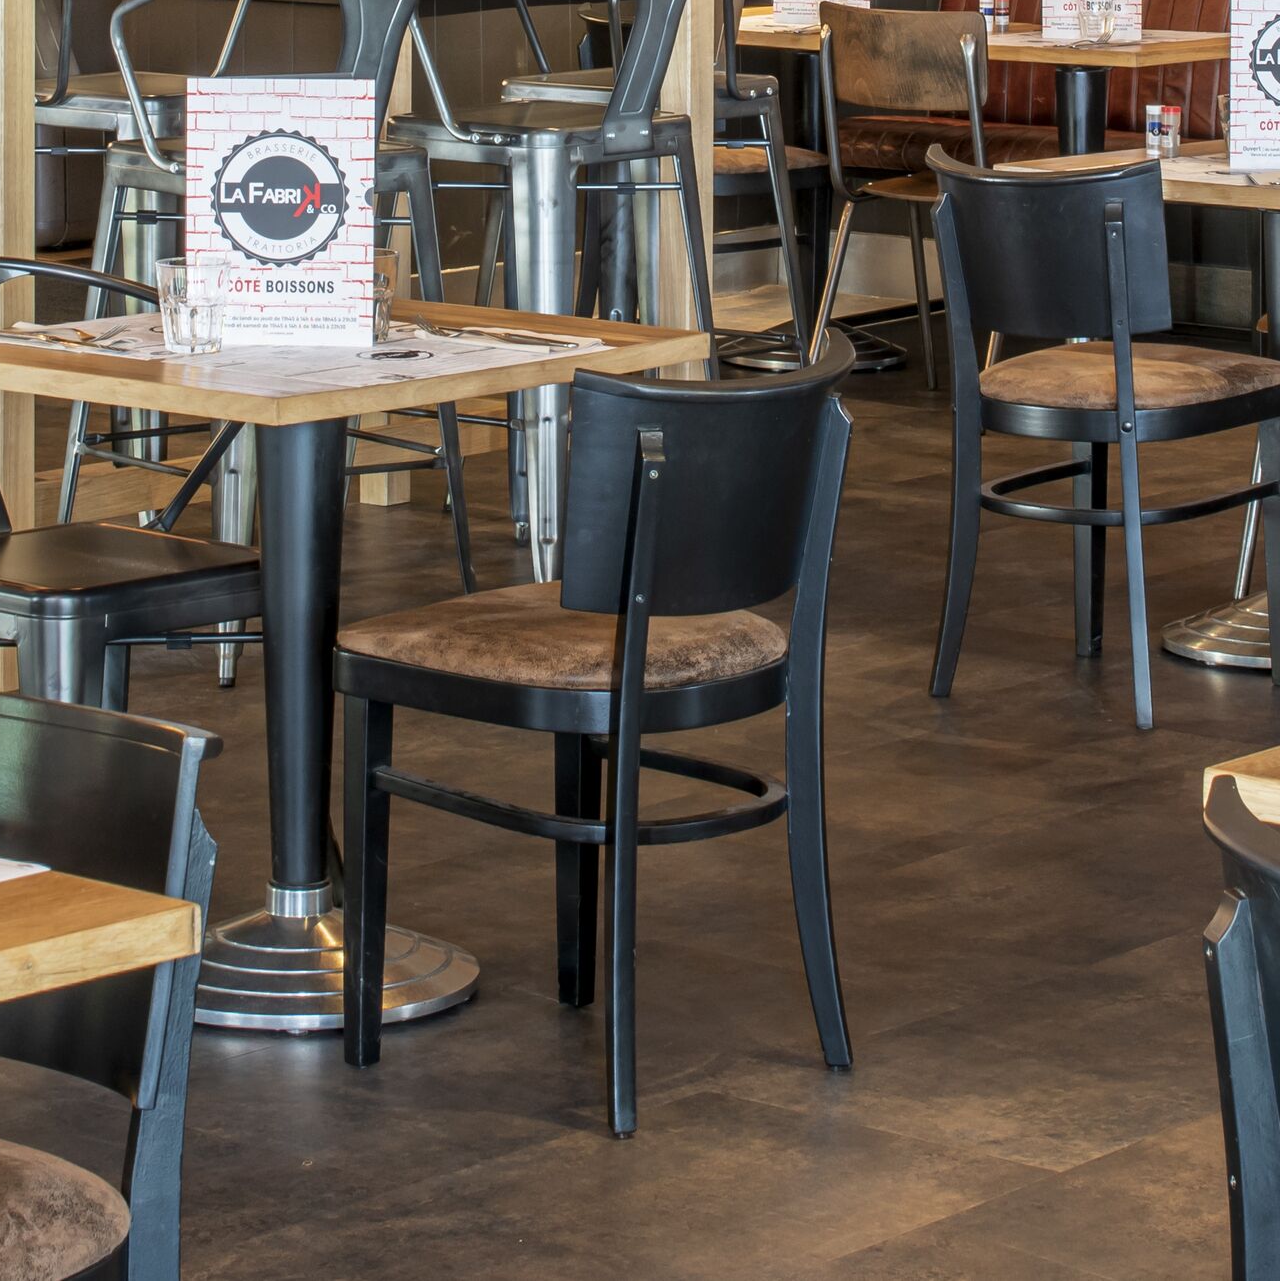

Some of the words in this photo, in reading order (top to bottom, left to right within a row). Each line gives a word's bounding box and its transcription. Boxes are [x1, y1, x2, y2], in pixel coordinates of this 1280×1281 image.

[1255, 48, 1276, 66] LA
[246, 143, 318, 163] BRASSERIE
[220, 181, 246, 204] LA
[248, 181, 320, 218] FABRIK
[306, 203, 315, 214] &
[320, 203, 337, 214] CO
[246, 235, 319, 255] TRATTORIA
[266, 279, 335, 294] BOISSONS
